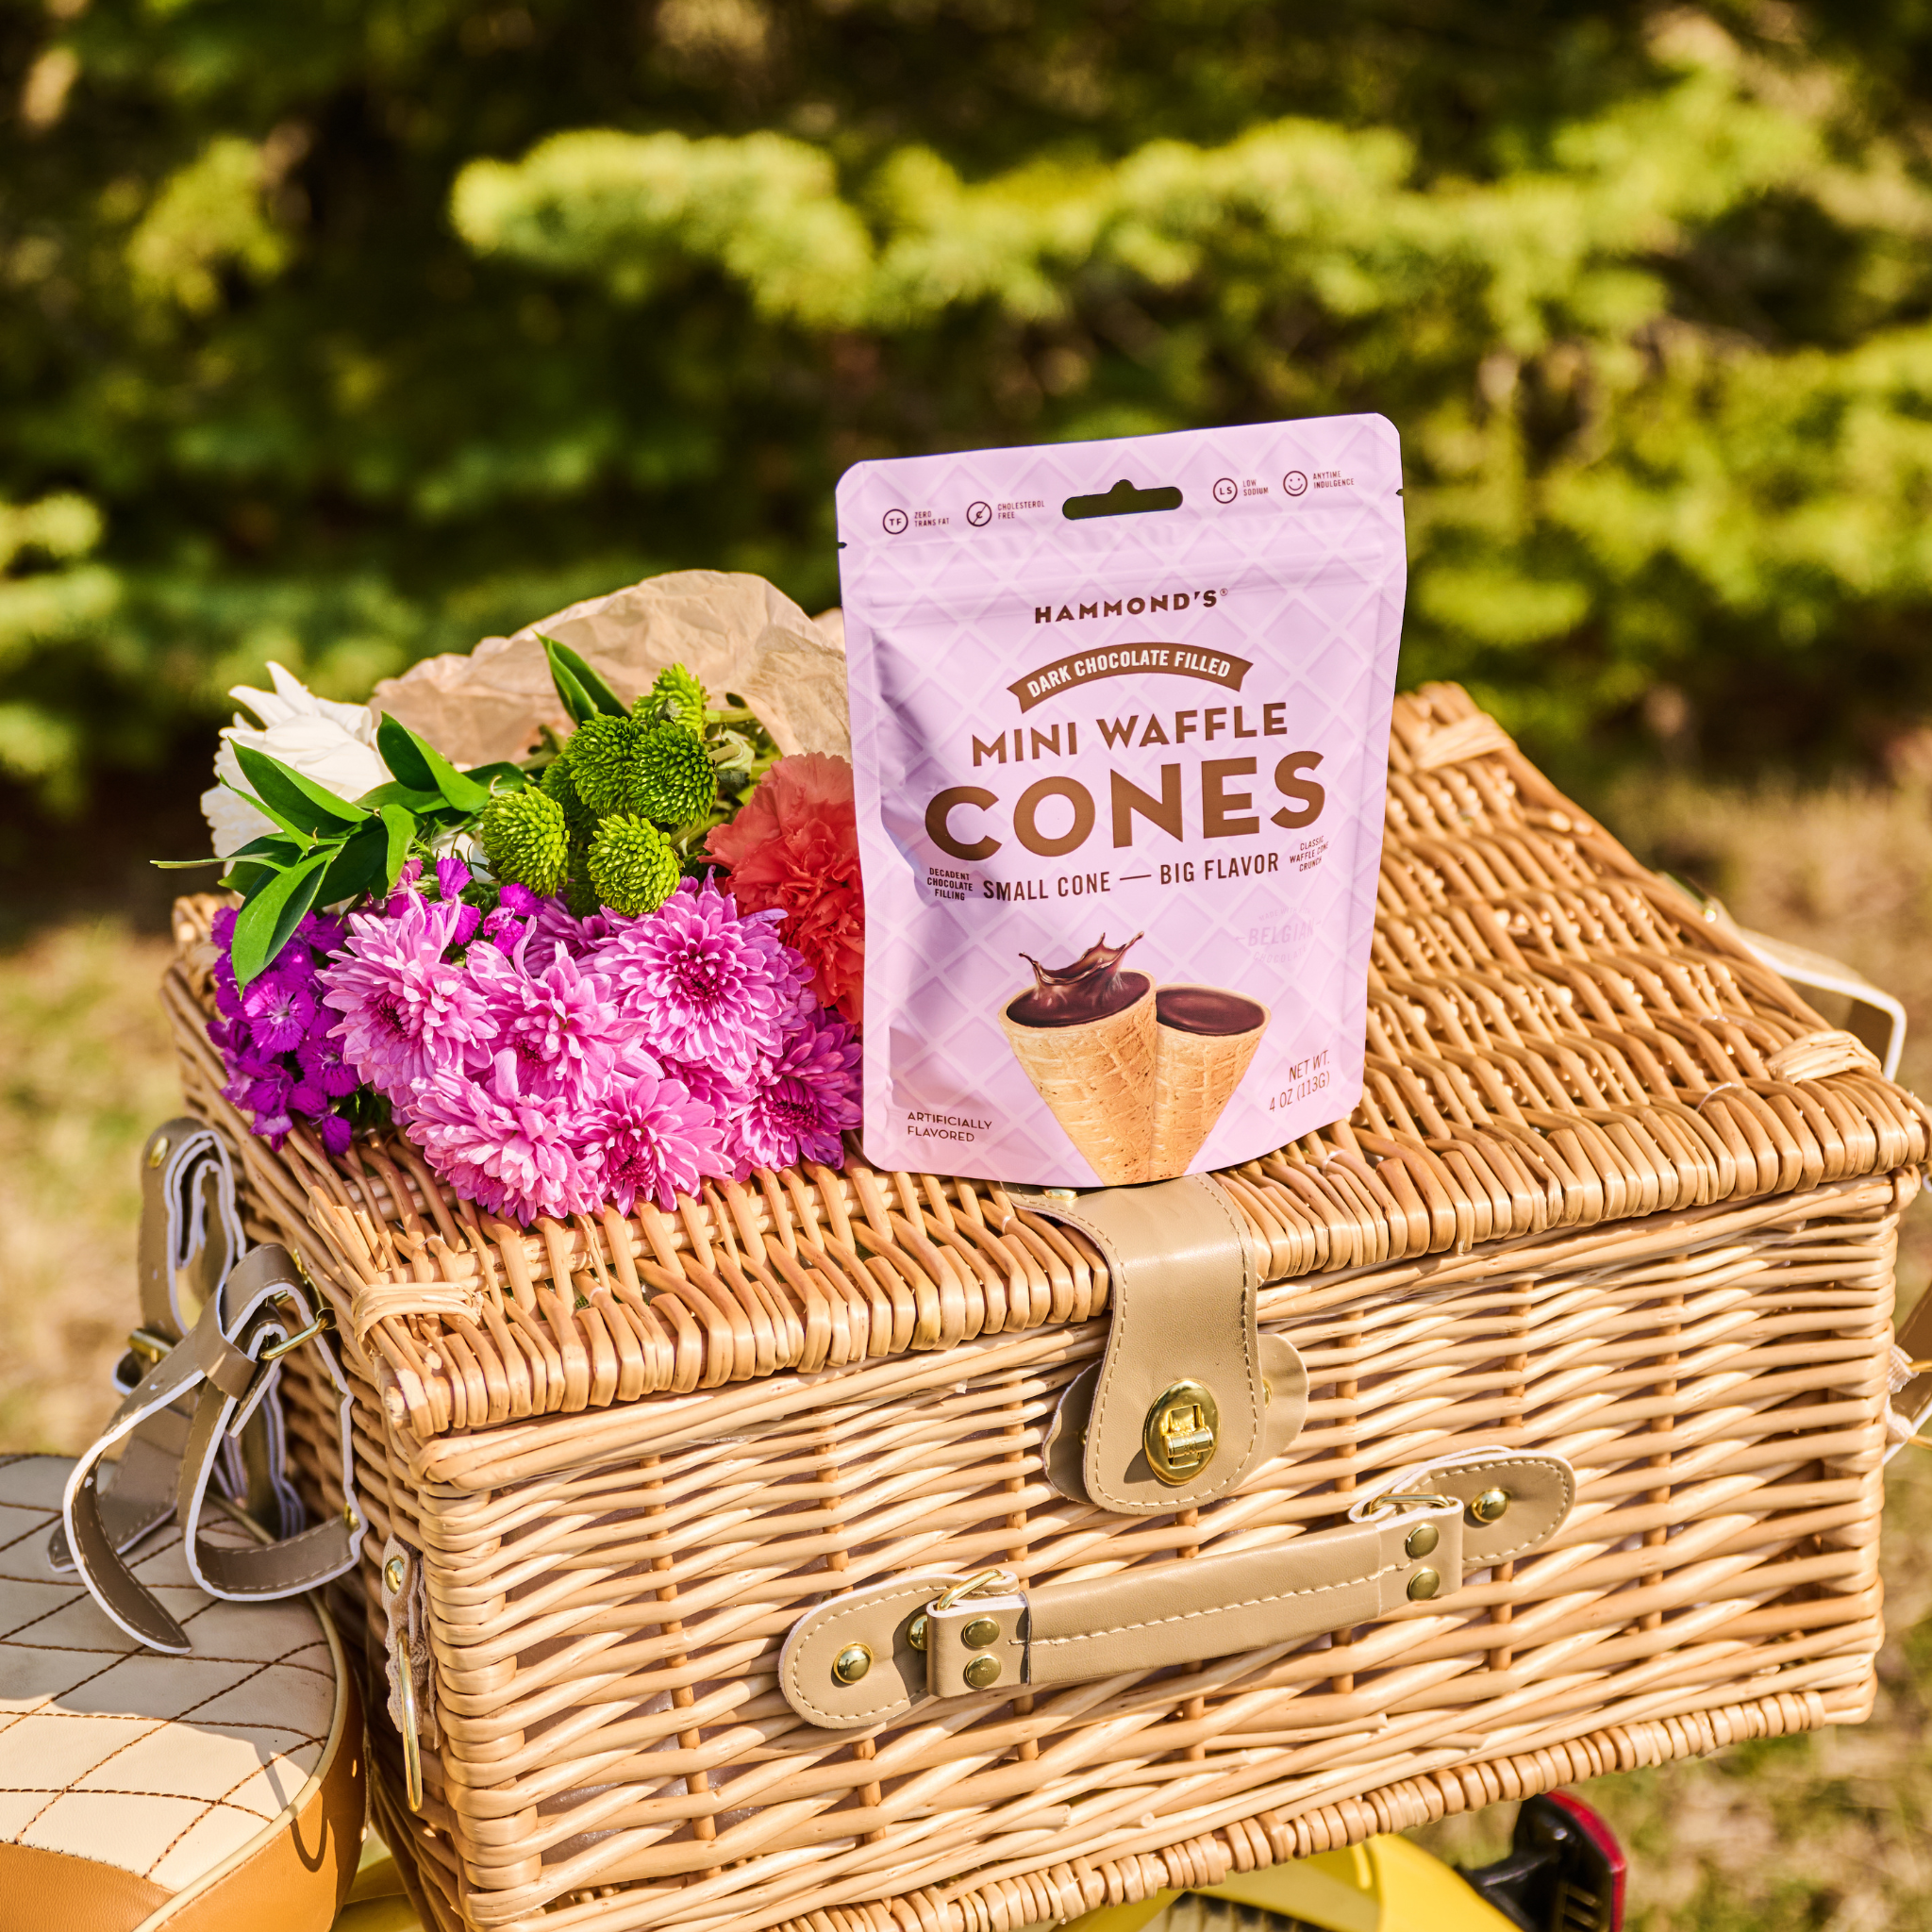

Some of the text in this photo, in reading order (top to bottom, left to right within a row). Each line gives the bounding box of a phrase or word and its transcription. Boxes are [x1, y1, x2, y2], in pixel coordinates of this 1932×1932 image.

[1312, 471, 1341, 480] ANYTIME
[1242, 479, 1257, 488] LOW
[1313, 478, 1355, 490] INDULGENCE
[1242, 487, 1269, 496] SODIUM
[997, 500, 1045, 511] CHOLESTEROL
[914, 510, 932, 519] ZERO
[998, 511, 1015, 520] FREE
[914, 519, 937, 527] TRANS
[1026, 649, 1231, 698] DARK CHOCOLATE FILLED
[972, 702, 1288, 767] MINI WAFFLE
[924, 750, 1326, 861] CONES
[1300, 835, 1324, 851] CLASSIC
[1290, 849, 1315, 863] WAFFLE
[929, 867, 970, 880] DECADENT
[983, 852, 1279, 902] SMALL CONE BIG FLAVOR
[926, 877, 973, 891] CHOCOLATE
[935, 889, 965, 901] FILLING
[1248, 917, 1315, 947] BELGIAN
[1253, 944, 1307, 964] CHOCOLATE
[1289, 1049, 1330, 1083] NET WT.
[1269, 1070, 1330, 1112] 4 OZ (113G)
[907, 1111, 992, 1130] ARTIFICIALLY
[907, 1125, 975, 1142] FLAVORED
